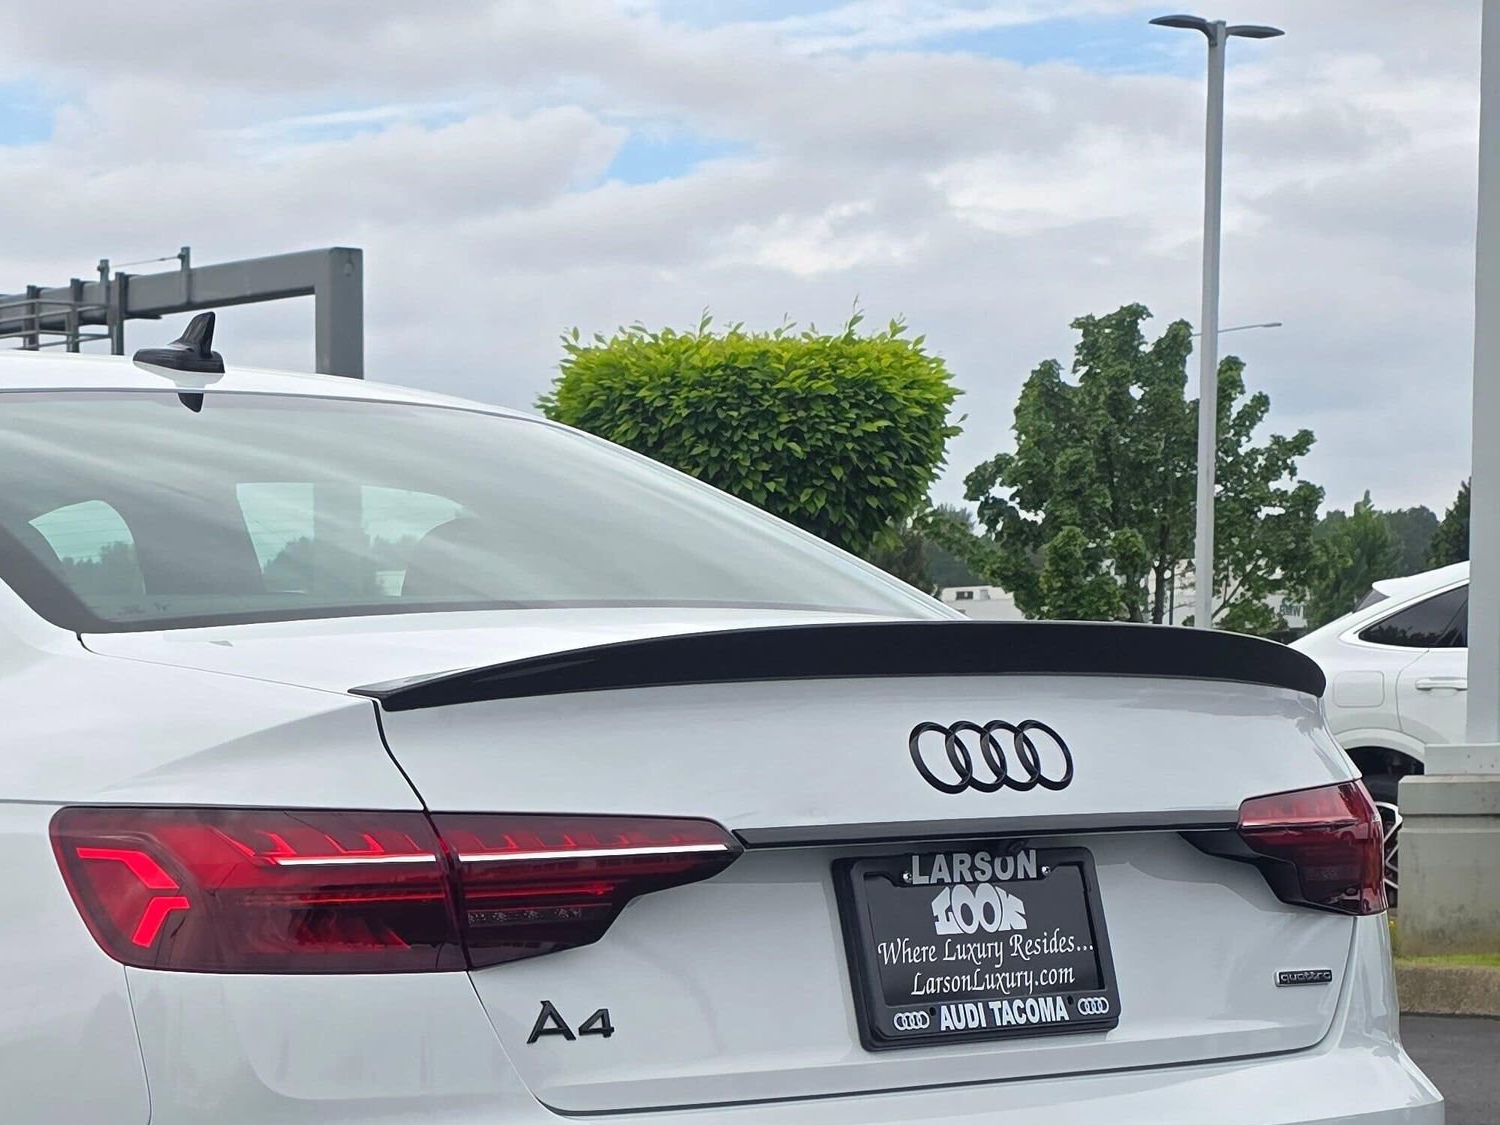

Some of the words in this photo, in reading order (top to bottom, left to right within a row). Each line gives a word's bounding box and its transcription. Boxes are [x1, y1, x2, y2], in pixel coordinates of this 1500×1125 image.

[911, 849, 1037, 885] LARSON
[877, 936, 938, 967] Where
[942, 938, 1004, 969] Luxury
[1009, 927, 1094, 961] Resides...
[910, 966, 1076, 996] LarsonLuxury.com
[1280, 971, 1332, 984] quattro
[526, 1000, 615, 1045] A4
[940, 1002, 987, 1032] AUDI
[989, 995, 1070, 1027] TACOMA
